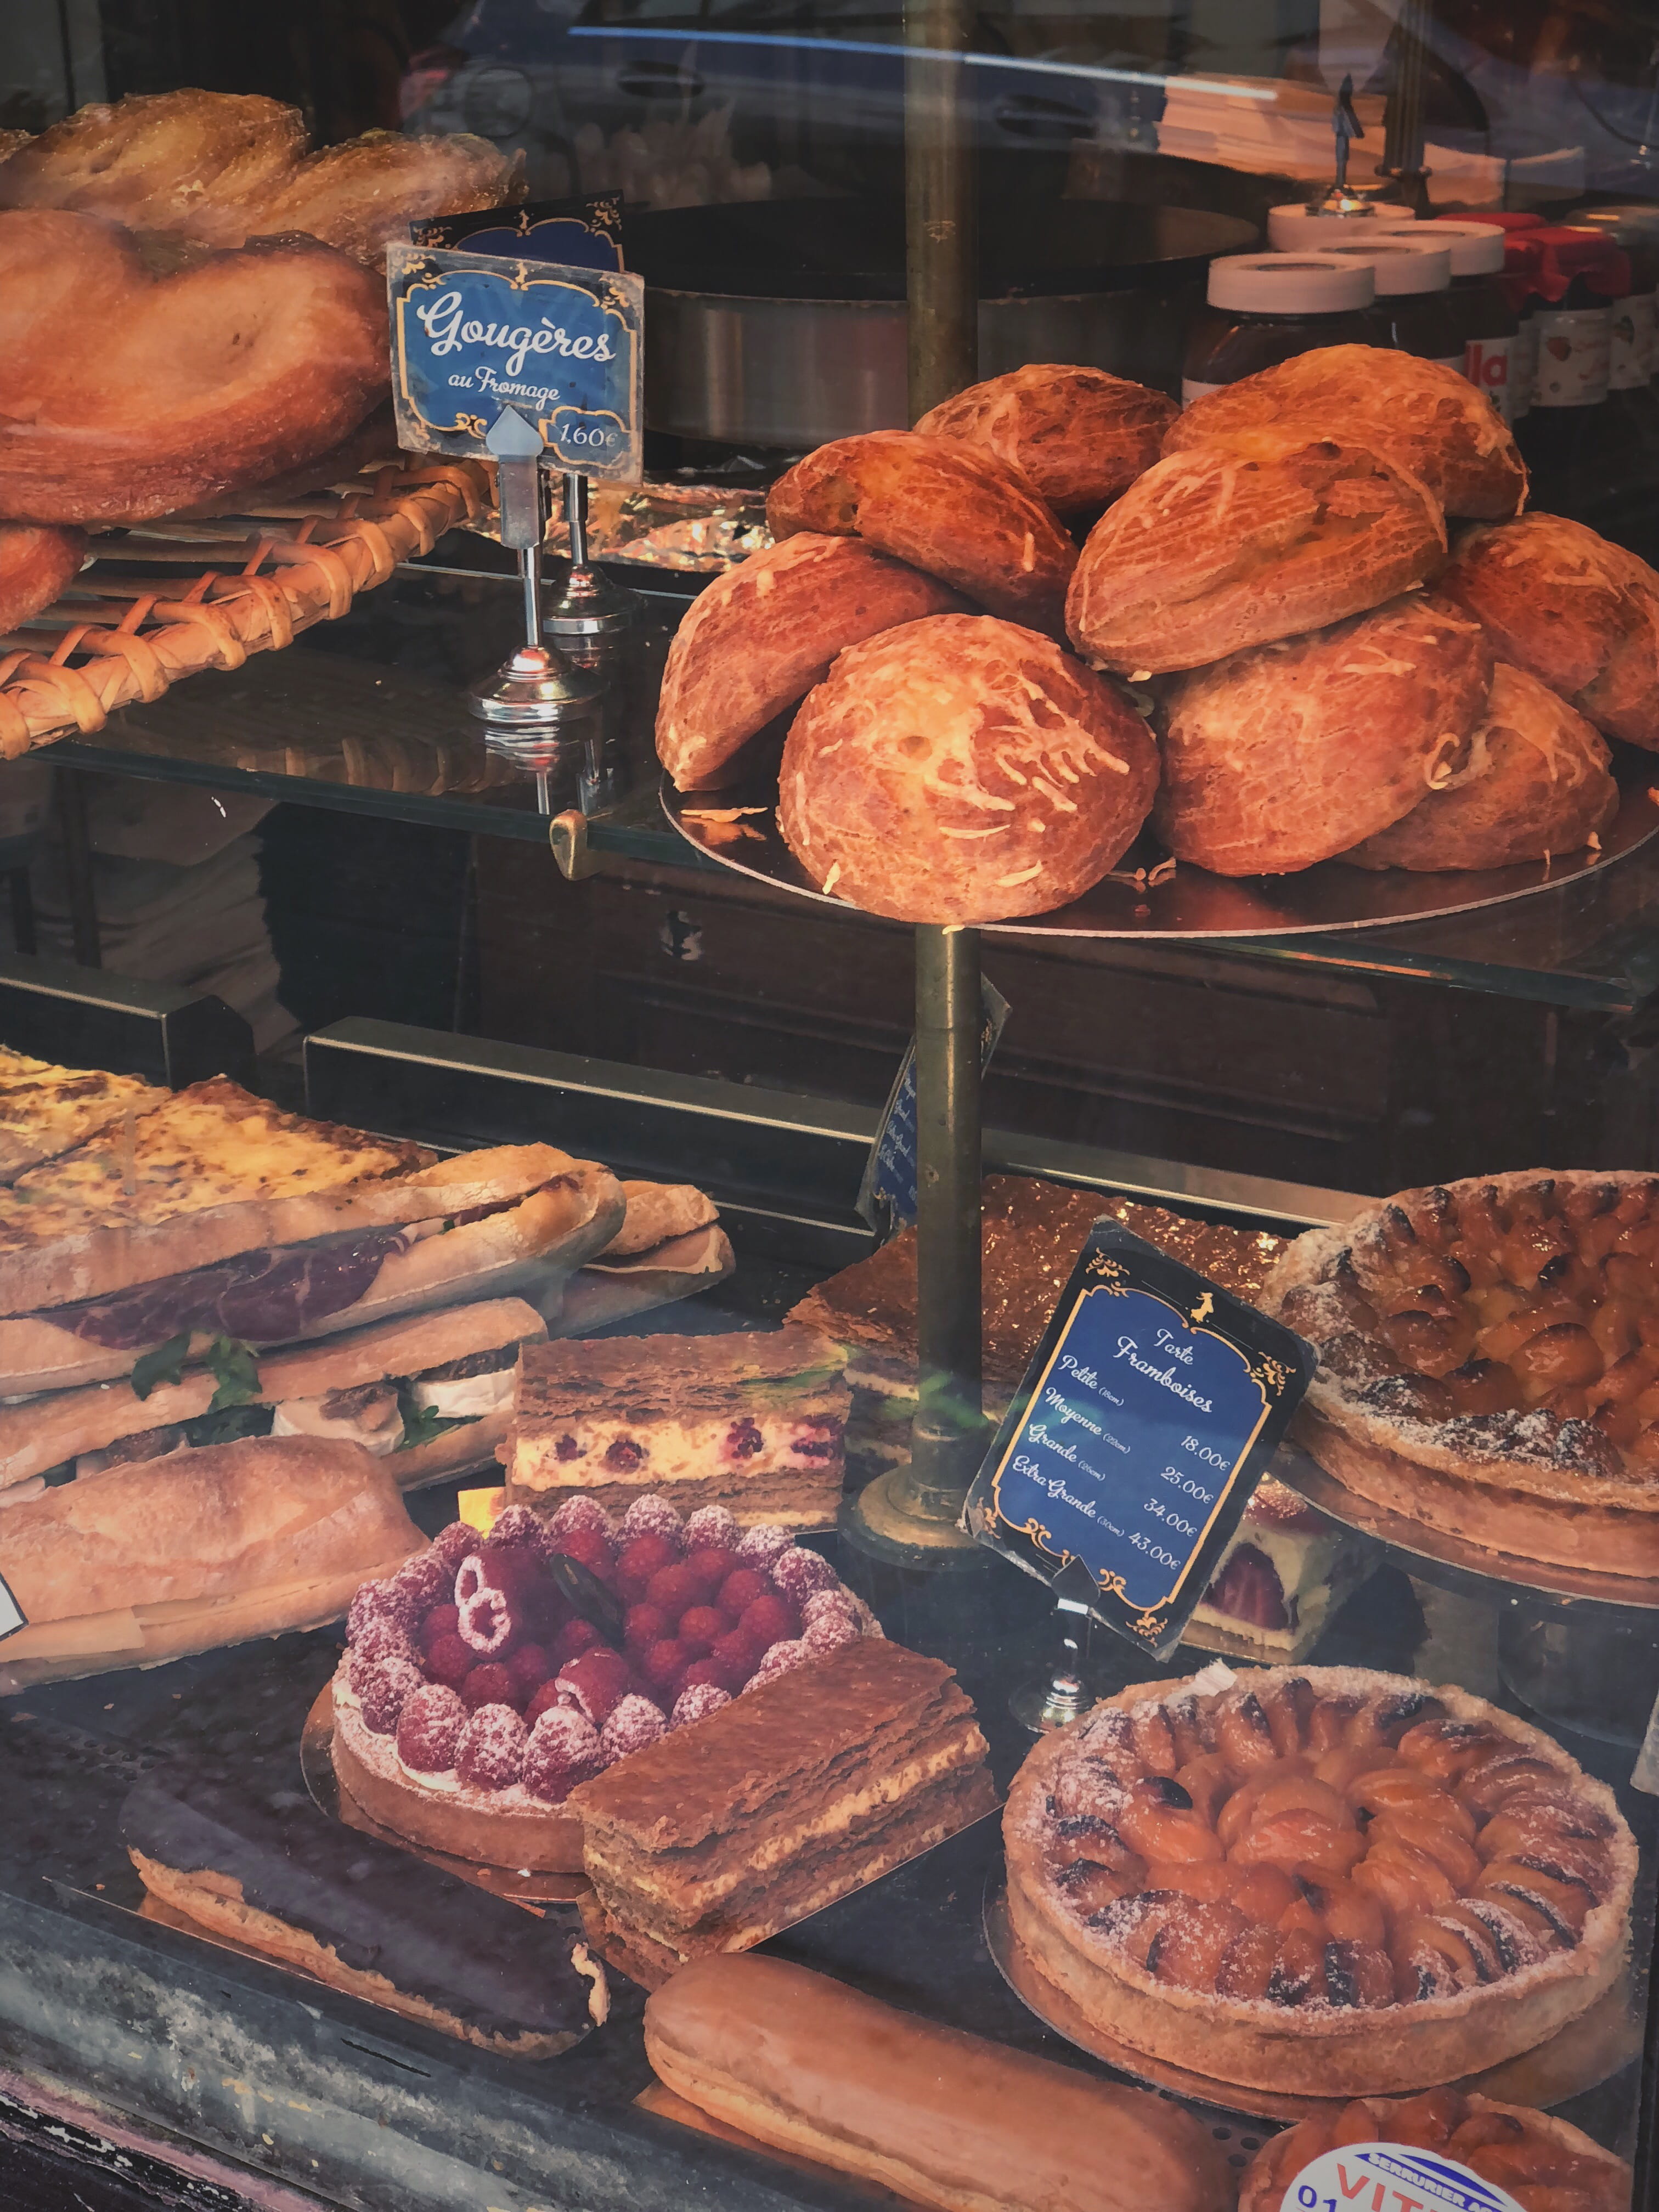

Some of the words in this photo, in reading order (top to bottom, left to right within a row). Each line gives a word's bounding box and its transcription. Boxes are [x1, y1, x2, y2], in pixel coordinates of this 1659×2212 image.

[416, 291, 616, 376] Gougères
[448, 374, 474, 388] au
[475, 366, 560, 411] Fromage
[1113, 1336, 1212, 1412] Framboises
[1154, 1329, 1193, 1365] Tarte
[1045, 1387, 1101, 1435] Moyenne
[1103, 1433, 1131, 1454] (22cm)
[1160, 1466, 1214, 1504] 25.00€
[1058, 1355, 1098, 1389] Petite
[1099, 1387, 1124, 1406] (18cm)
[1181, 1436, 1231, 1471] 18.00€
[1012, 1455, 1047, 1486] Extra
[1047, 1480, 1096, 1519] Grande
[1128, 1532, 1181, 1570] 43.00€
[1029, 1424, 1077, 1463] Grande
[1143, 1498, 1198, 1537] 34.00€
[1337, 2163, 1438, 2212] VIT
[1368, 2153, 1465, 2208] SERRURIER
